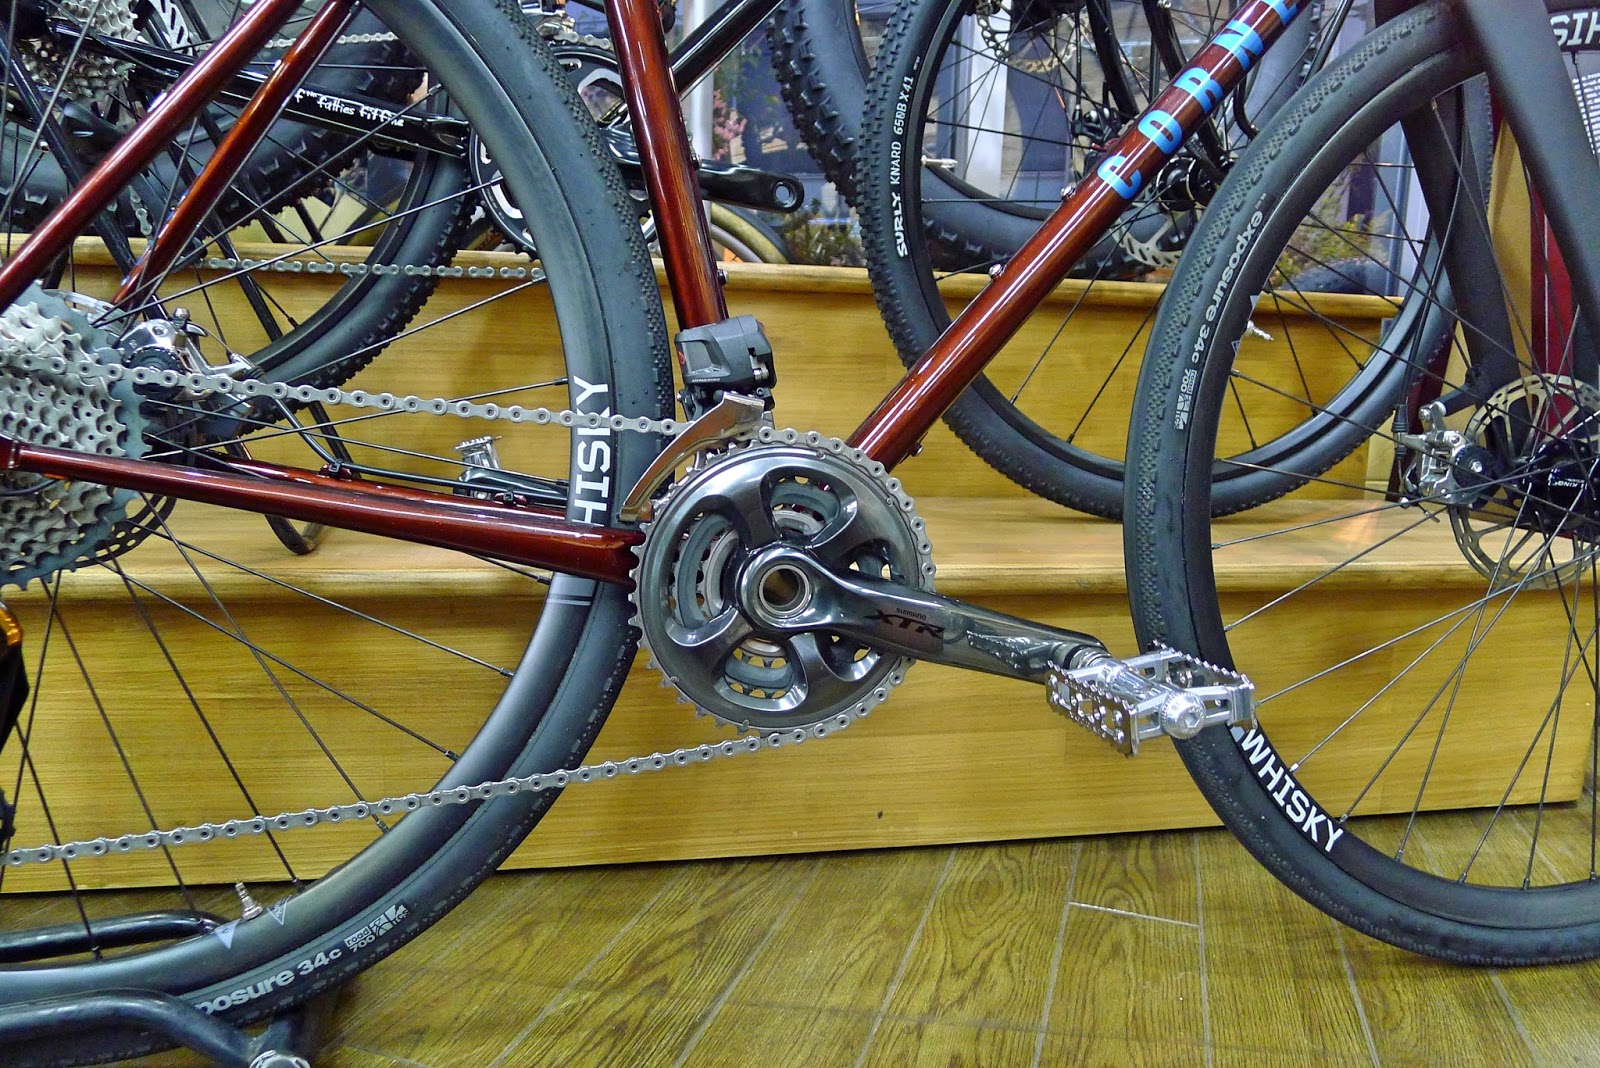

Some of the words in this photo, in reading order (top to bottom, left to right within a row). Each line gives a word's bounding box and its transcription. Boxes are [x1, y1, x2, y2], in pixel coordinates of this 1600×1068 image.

[902, 76, 914, 92] 41
[316, 96, 356, 115] fatties
[893, 102, 907, 135] 650B
[890, 141, 901, 185] KNARD
[891, 192, 908, 258] SURLY
[1205, 210, 1263, 322] exposure
[1191, 324, 1210, 364] 34c
[1180, 368, 1192, 393] 700
[572, 375, 610, 527] HISKY
[863, 609, 945, 640] XTR
[1241, 729, 1343, 852] WHISKY
[344, 926, 372, 948] road
[349, 934, 376, 953] 700
[195, 970, 295, 1015] posure
[297, 948, 342, 977] 34c
